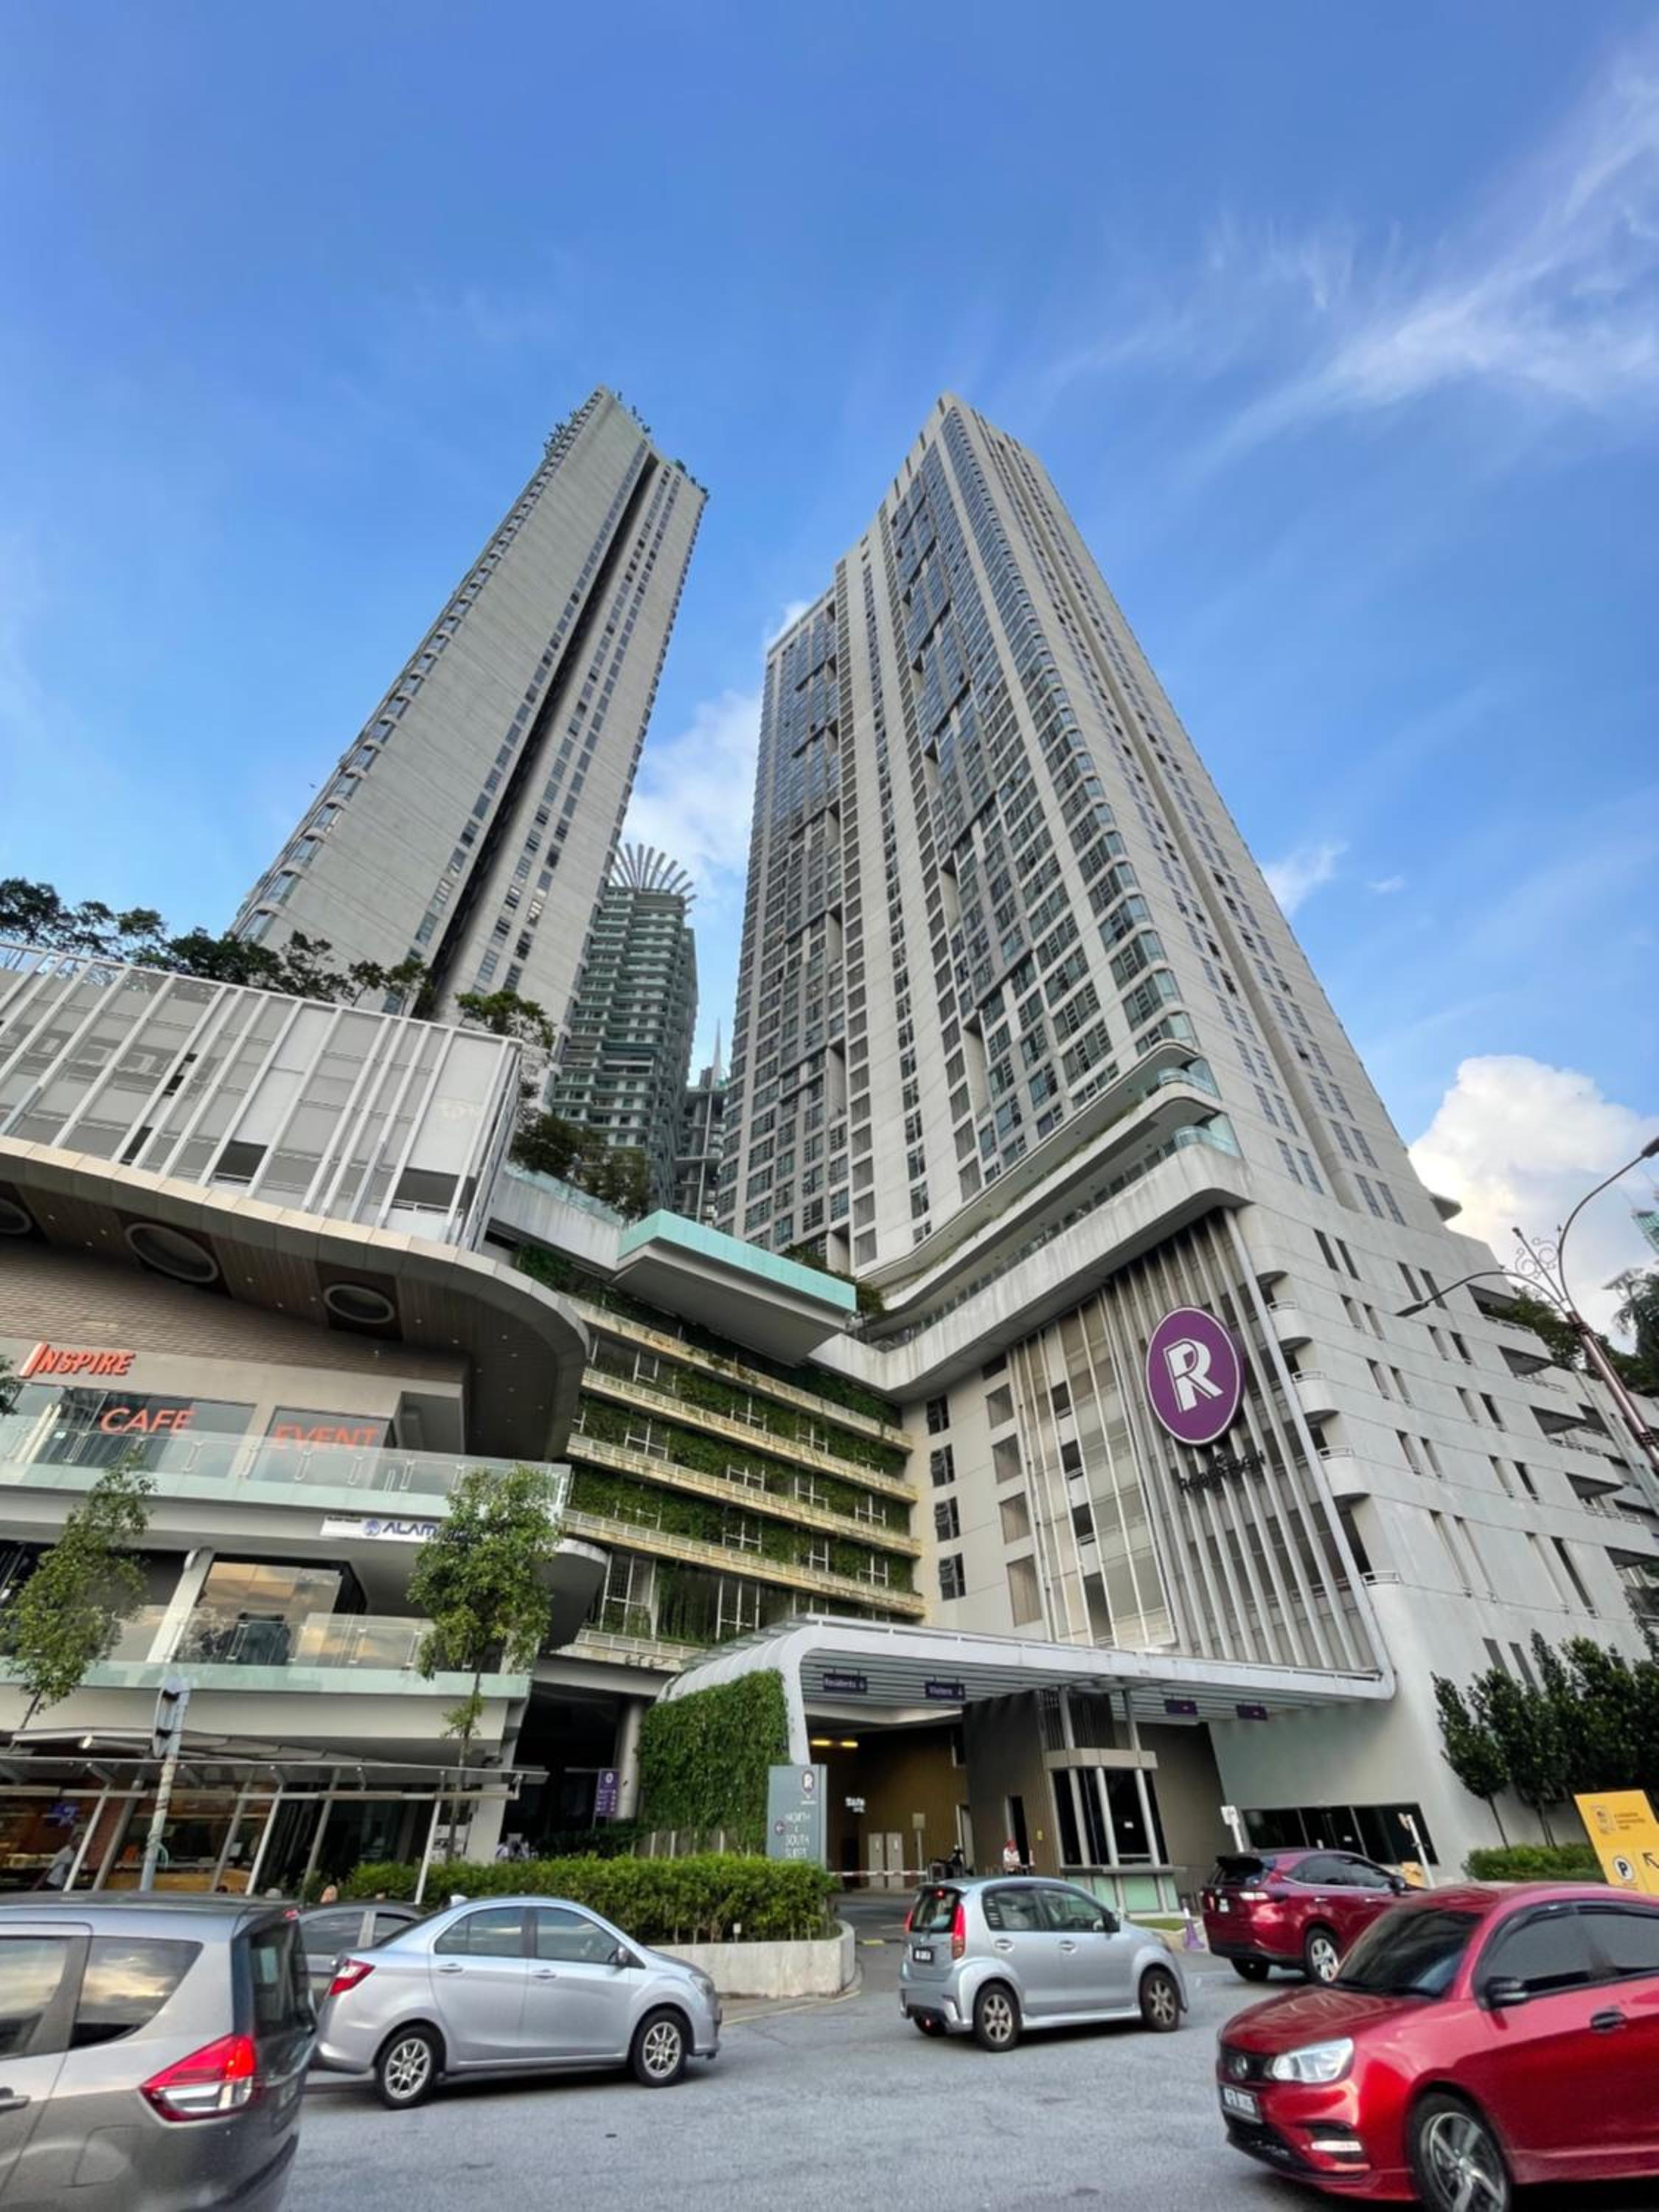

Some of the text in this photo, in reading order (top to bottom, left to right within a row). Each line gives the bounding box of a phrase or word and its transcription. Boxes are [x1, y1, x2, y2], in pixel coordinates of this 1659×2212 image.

[18, 1341, 136, 1378] INSPIRE
[1163, 1338, 1224, 1413] R
[100, 1407, 196, 1433] CAFE
[274, 1425, 378, 1449] EVENT
[1617, 1860, 1628, 1877] P
